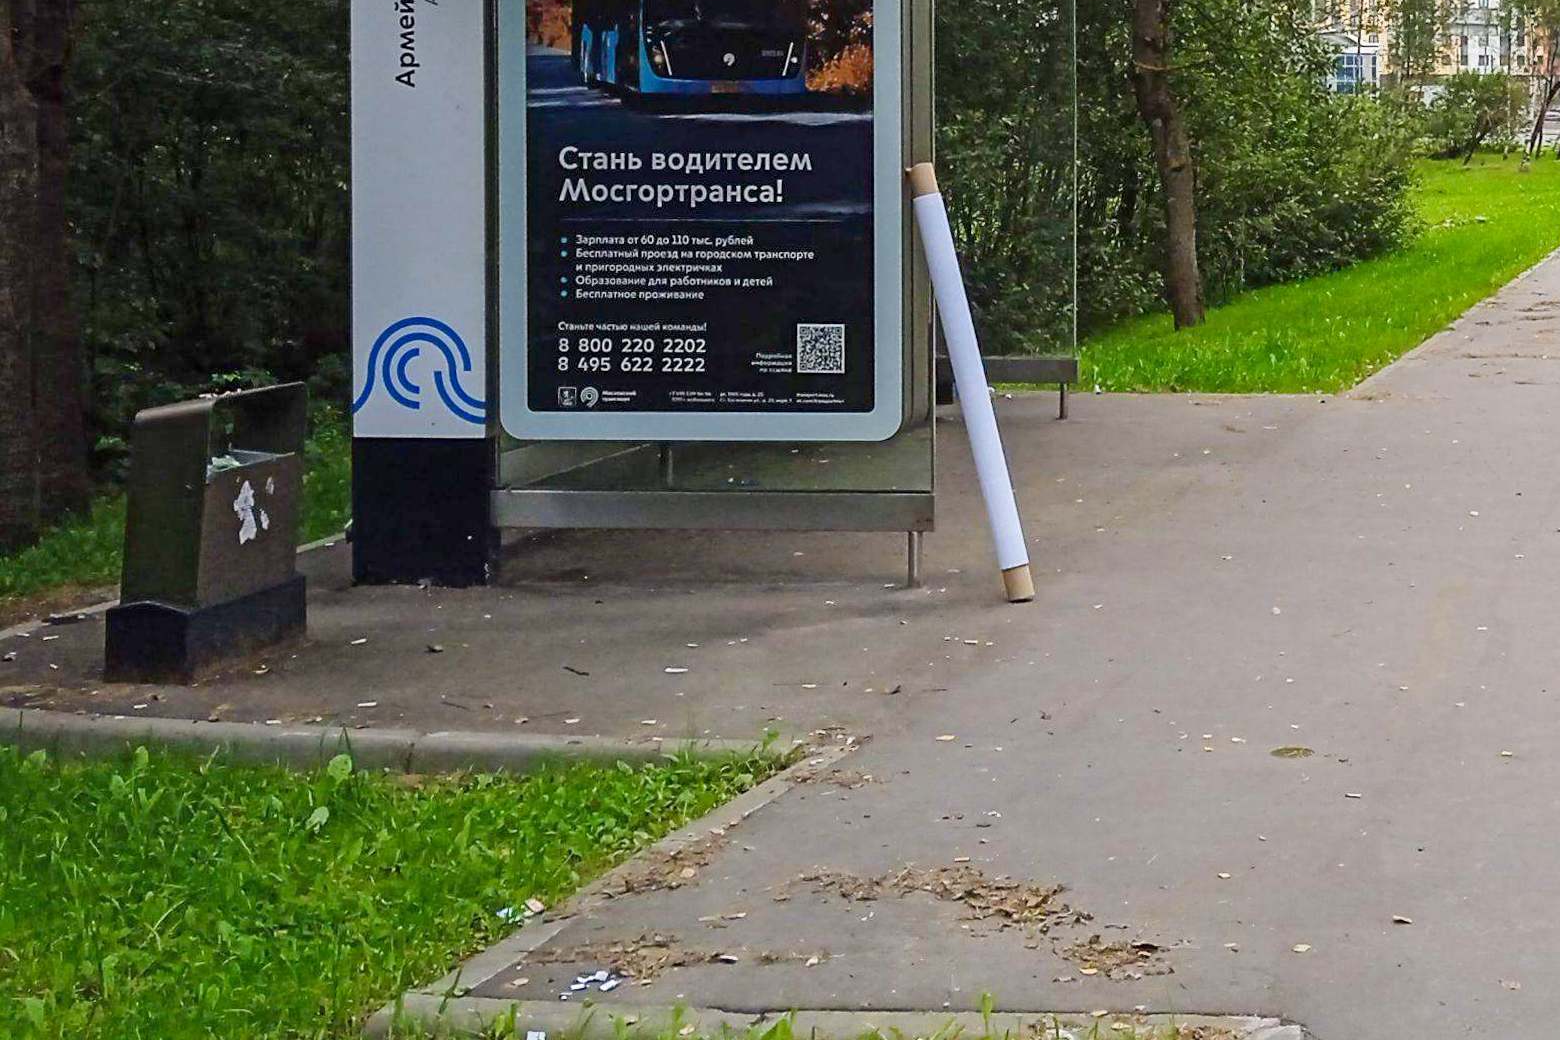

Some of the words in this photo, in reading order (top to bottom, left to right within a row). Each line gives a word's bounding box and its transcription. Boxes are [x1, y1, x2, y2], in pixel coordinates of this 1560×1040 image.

[558, 146, 643, 171] Стань
[651, 151, 813, 174] водителем
[558, 178, 784, 208] Мосгортранса!
[575, 234, 625, 246] Зарплата
[627, 236, 639, 245] от
[640, 234, 654, 245] 60
[656, 236, 670, 246] до
[671, 234, 690, 245] 110
[691, 236, 713, 245] тыс.
[715, 234, 754, 247] рублей
[575, 248, 639, 258] Бесплатный
[641, 250, 679, 260] проезд
[680, 250, 693, 258] на
[695, 250, 752, 260] городском
[754, 250, 815, 261] транспорте
[575, 264, 583, 272] и
[585, 264, 655, 273] пригородных
[657, 264, 722, 274] электричках
[575, 275, 646, 287] Образование
[648, 278, 667, 286] для
[670, 275, 731, 288] работников
[734, 279, 741, 287] и
[742, 276, 773, 287] детей
[575, 288, 637, 299] Бесплатное
[638, 291, 705, 301] проживание
[557, 321, 594, 331] Станьте
[596, 323, 627, 331] частью
[630, 322, 661, 331] нашей
[662, 322, 707, 332] команды!
[558, 338, 570, 353] 8
[578, 338, 613, 353] 800
[621, 338, 655, 353] 220
[663, 338, 707, 353] 2202
[557, 357, 569, 372] 8
[577, 357, 611, 372] 495
[620, 357, 653, 372] 622
[661, 357, 706, 373] 2222
